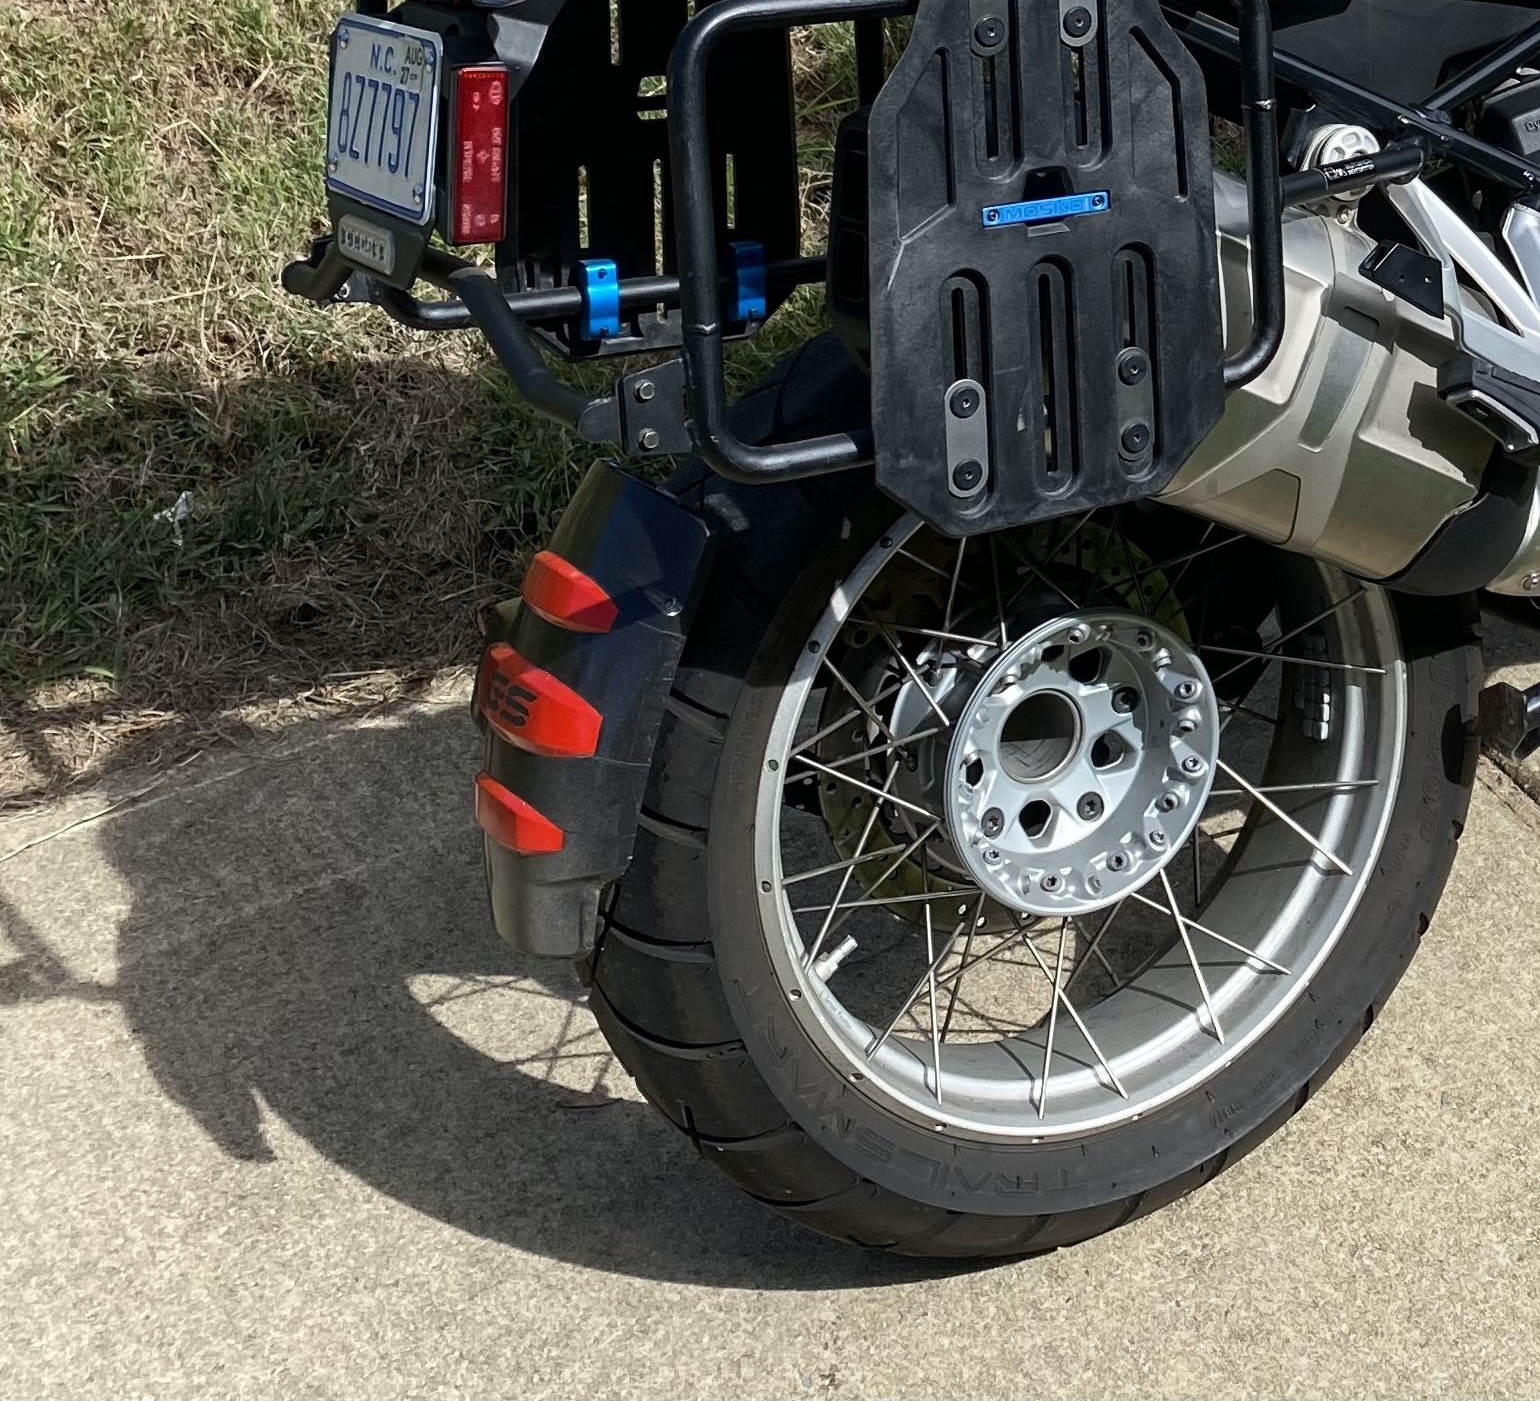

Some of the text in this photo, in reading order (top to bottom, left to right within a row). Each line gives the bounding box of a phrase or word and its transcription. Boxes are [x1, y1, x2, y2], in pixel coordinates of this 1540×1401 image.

[370, 42, 397, 76] N.C.
[404, 45, 424, 66] AUG
[400, 66, 411, 85] 27
[1004, 198, 1084, 222] MOSKO
